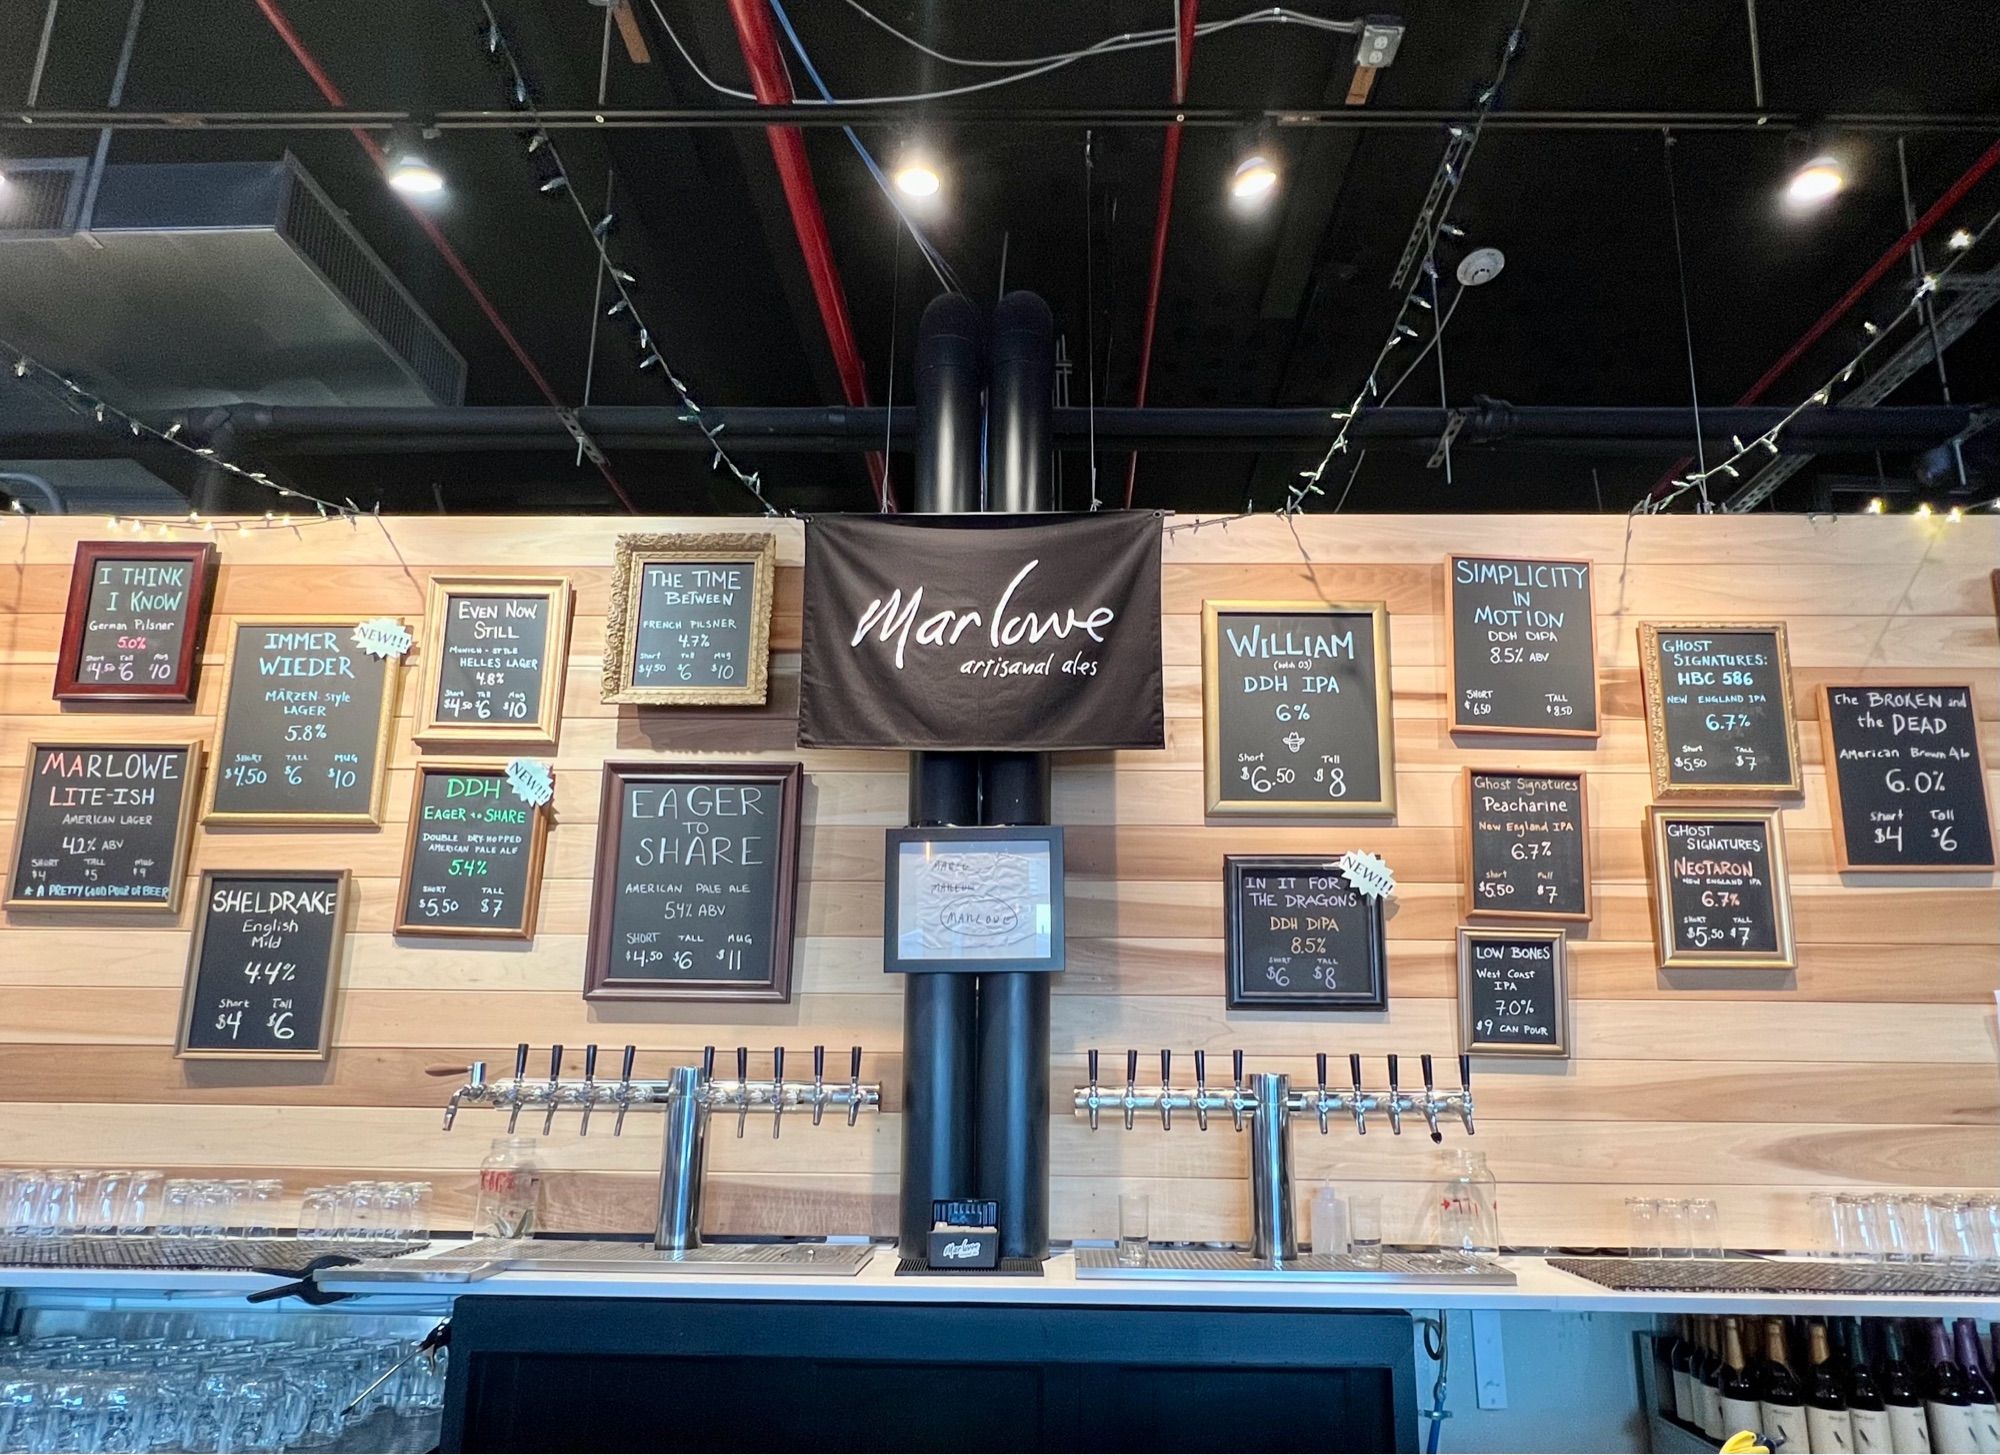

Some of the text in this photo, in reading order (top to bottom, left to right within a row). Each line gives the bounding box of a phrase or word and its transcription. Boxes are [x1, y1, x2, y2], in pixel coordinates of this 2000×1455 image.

[99, 567, 183, 587] I THINK
[648, 570, 741, 589] THE TIME
[1457, 560, 1587, 590] SIMPLICITY
[106, 591, 183, 612] I KNOW
[665, 591, 733, 606] BETWEEN
[1513, 590, 1530, 607] IN
[459, 601, 537, 619] EVEN NOW
[851, 559, 1114, 670] Marlowe
[1474, 605, 1564, 628] MOTION
[89, 618, 175, 631] German Pilsner
[474, 621, 519, 639] STILL
[643, 619, 736, 629] FRENCH PILSNER
[264, 632, 340, 653] IMMER
[358, 627, 409, 650] NEW!!!
[679, 634, 710, 648] 4.7%
[1226, 624, 1354, 659] WILLIAM
[1488, 631, 1558, 642] DDH DIPA
[1662, 640, 1712, 653] GHOST
[460, 658, 538, 670] HELLES LAGER
[960, 651, 1097, 679] artisanal ales
[1529, 652, 1550, 662] ABV
[1674, 654, 1768, 667] SIGNATURES:
[260, 656, 355, 678] WIEDER
[677, 664, 734, 680] $6 $10
[1244, 675, 1340, 694] DDH IPA
[1678, 672, 1753, 686] HBC 586
[1466, 690, 1568, 702] SHORT TALL
[1667, 695, 1688, 704] NEW
[1698, 695, 1744, 704] ENGLAND
[1867, 692, 1942, 709] BROKEN
[284, 706, 326, 716] LAGER
[475, 700, 490, 718] $6
[503, 702, 527, 718] $10
[1706, 713, 1751, 731] 6.7%
[1857, 711, 1947, 736] the DEAD
[284, 724, 327, 741] 5.8%
[42, 752, 178, 779] MARLOWE
[335, 754, 358, 763] MUG
[1237, 753, 1264, 762] Short
[1736, 755, 1757, 772] $7
[284, 766, 302, 785] $6
[328, 768, 356, 789] $10
[1475, 776, 1578, 796] Ghost Signatures
[1885, 769, 1945, 793] 6.0%
[50, 786, 155, 806] LITE-ISH
[447, 779, 500, 799] DDH
[632, 785, 764, 819] EAGER
[1482, 796, 1568, 812] Peacharine
[62, 814, 152, 825] AMERICAN LAGER
[424, 806, 526, 823] EAGER SHARE
[682, 822, 709, 834] TO
[1479, 821, 1574, 837] New England IPA
[1668, 824, 1714, 837] GHOST
[102, 840, 124, 850] ABV
[423, 833, 458, 842] DOUBLE
[1874, 826, 1957, 853] $4 $6
[635, 837, 763, 866] SHARE
[1511, 841, 1551, 860] 6.7%
[448, 859, 488, 877] 5.4%
[1343, 855, 1394, 895] NEW!!!
[1674, 856, 1753, 878] NECTARON
[625, 884, 750, 894] AMERICAN PALE ALE
[1246, 877, 1341, 890] IN IT FOR
[213, 890, 336, 915] SHELDRAKE
[1249, 892, 1357, 909] THE DRAGONS
[1537, 885, 1558, 904] $7
[1702, 891, 1740, 908] 6.7%
[481, 899, 503, 918] $7
[698, 904, 725, 916] ABV
[243, 919, 298, 936] English
[1270, 916, 1339, 932] DDH DIPA
[251, 936, 281, 948] Mild
[626, 932, 660, 944] SHORT
[1291, 937, 1326, 954] 8.5%
[626, 950, 663, 967] $4.50
[673, 951, 693, 969] $6
[1476, 945, 1550, 960] LOW BONES
[244, 961, 296, 985] 4.4%
[1266, 966, 1336, 989] $6 $8
[1477, 968, 1500, 978] West
[1494, 982, 1517, 991] IPA
[1496, 1000, 1534, 1016] 7.0%
[216, 1011, 294, 1040] $4 $6
[1476, 1019, 1548, 1036] $9 CAN POUR
